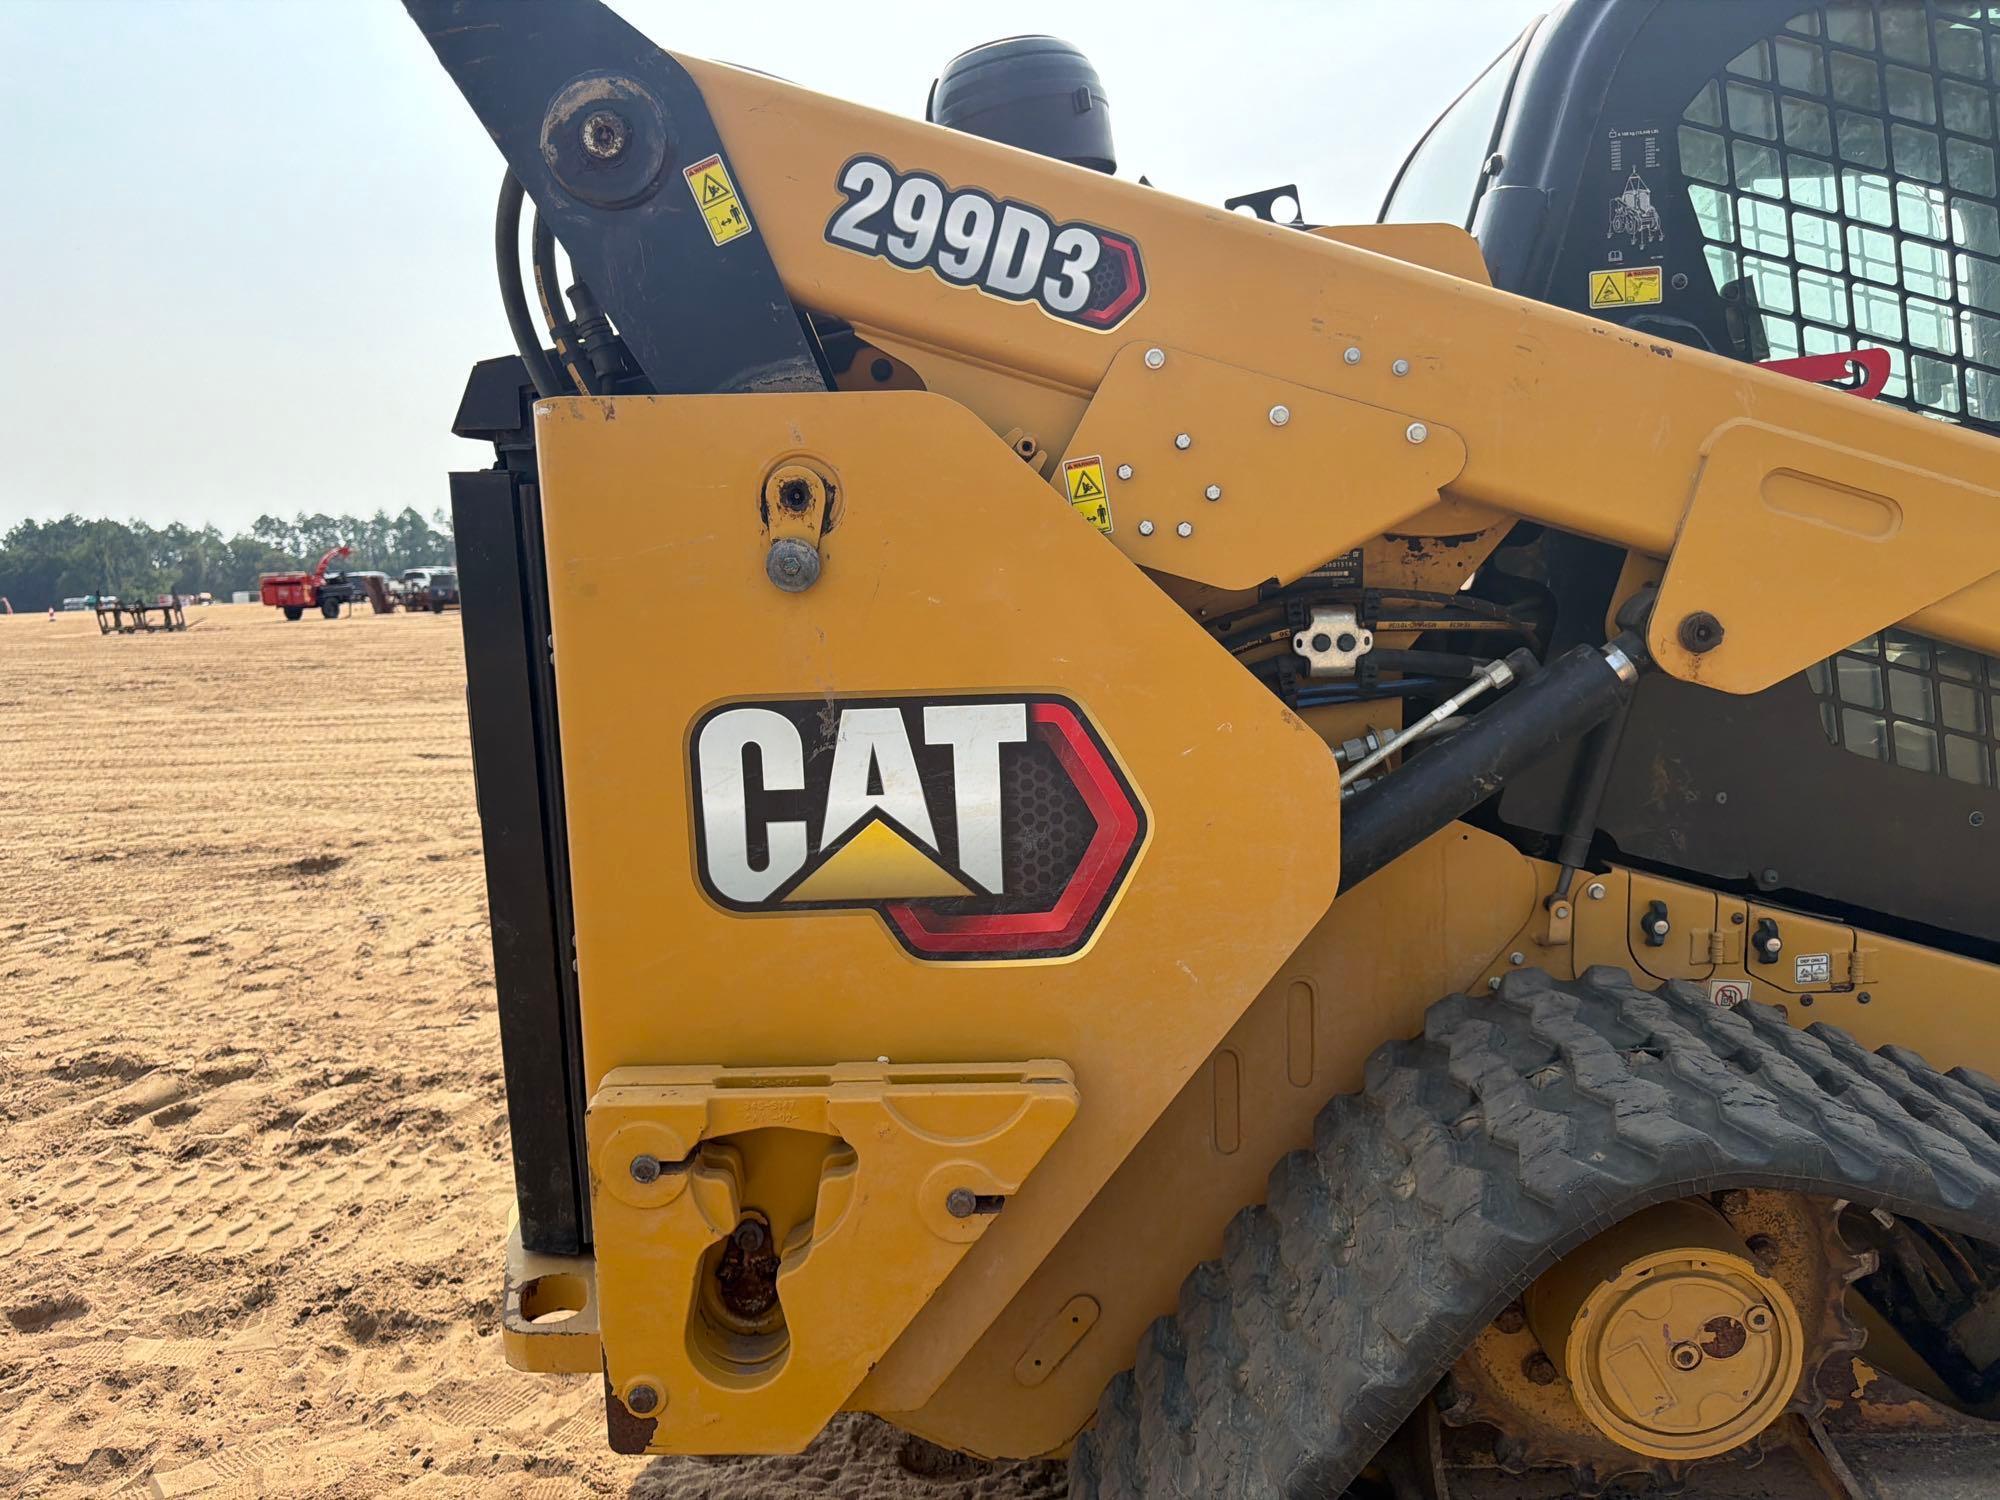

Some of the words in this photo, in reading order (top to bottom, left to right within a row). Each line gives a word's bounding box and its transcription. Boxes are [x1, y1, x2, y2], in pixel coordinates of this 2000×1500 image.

[694, 158, 719, 175] WARNING
[831, 160, 1101, 314] 299D3
[1073, 457, 1099, 469] WARNING
[699, 703, 1028, 903] CAT
